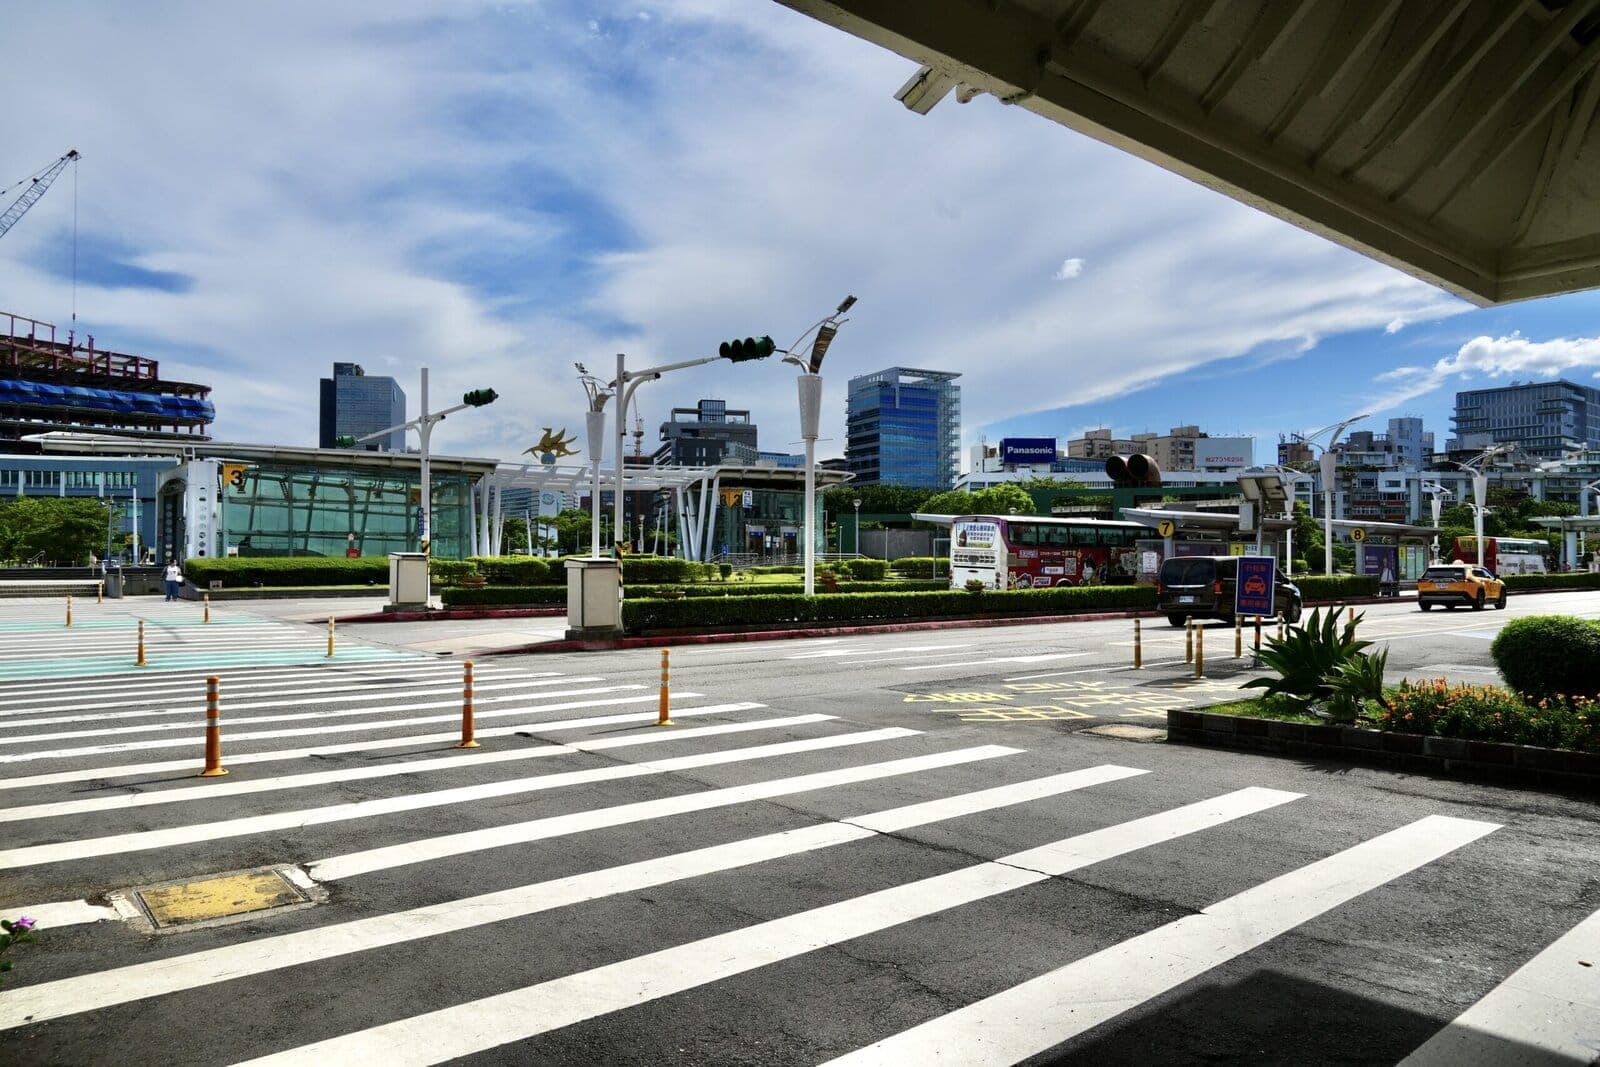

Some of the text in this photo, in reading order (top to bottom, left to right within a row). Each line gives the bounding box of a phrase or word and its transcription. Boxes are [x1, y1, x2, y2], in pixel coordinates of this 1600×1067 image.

[1006, 446, 1054, 455] Panasonic
[230, 470, 243, 486] 3
[1161, 522, 1171, 535] 7
[1354, 530, 1362, 540] 8
